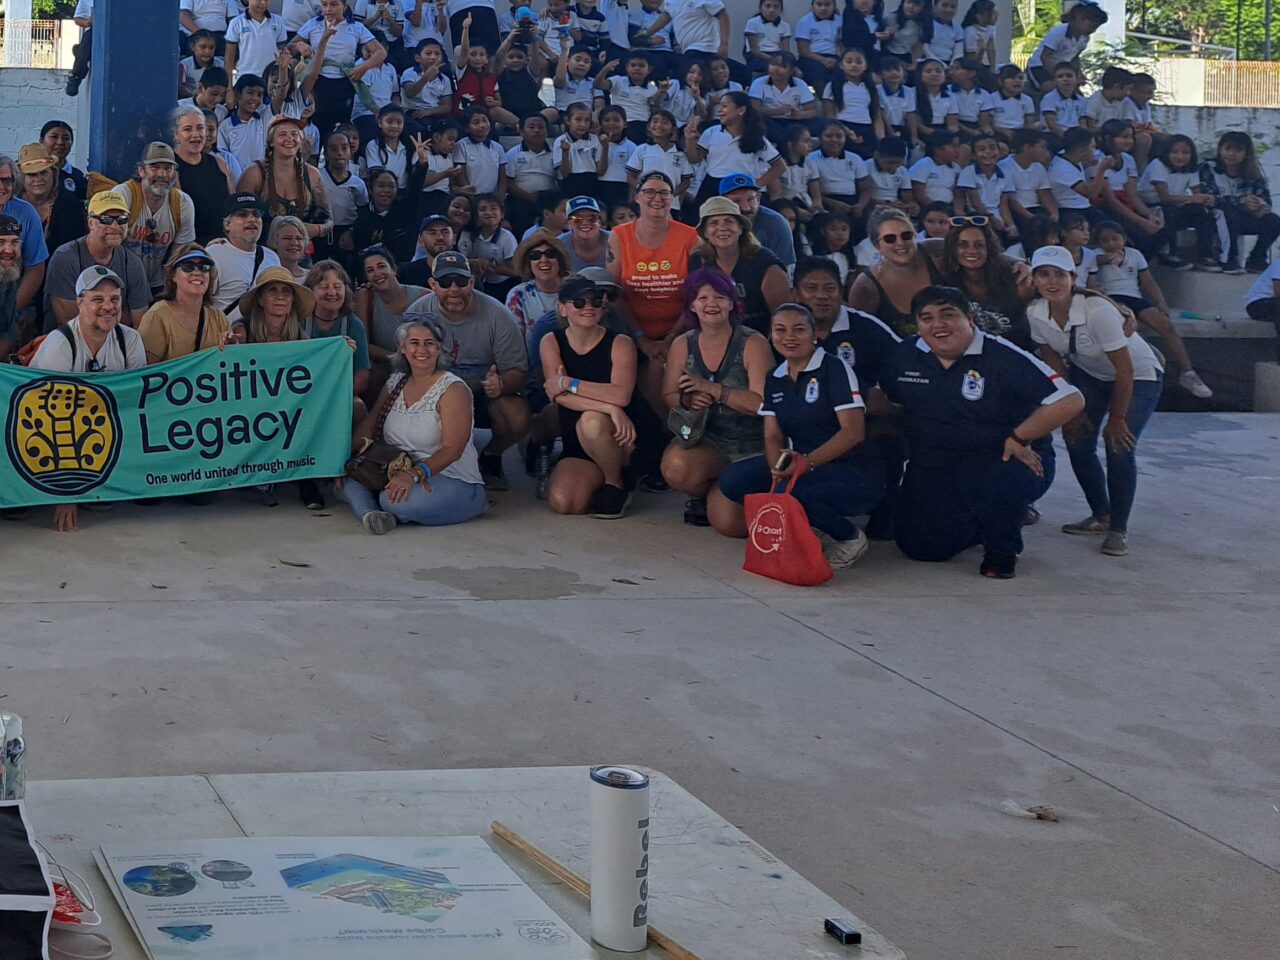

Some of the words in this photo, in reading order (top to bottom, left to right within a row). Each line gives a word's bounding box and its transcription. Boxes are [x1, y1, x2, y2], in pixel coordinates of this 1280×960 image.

[138, 358, 313, 409] Positive
[139, 407, 304, 459] Legacy
[146, 473, 168, 485] One
[170, 469, 202, 483] world
[205, 465, 239, 480] united
[241, 460, 284, 475] through
[286, 455, 316, 469] music
